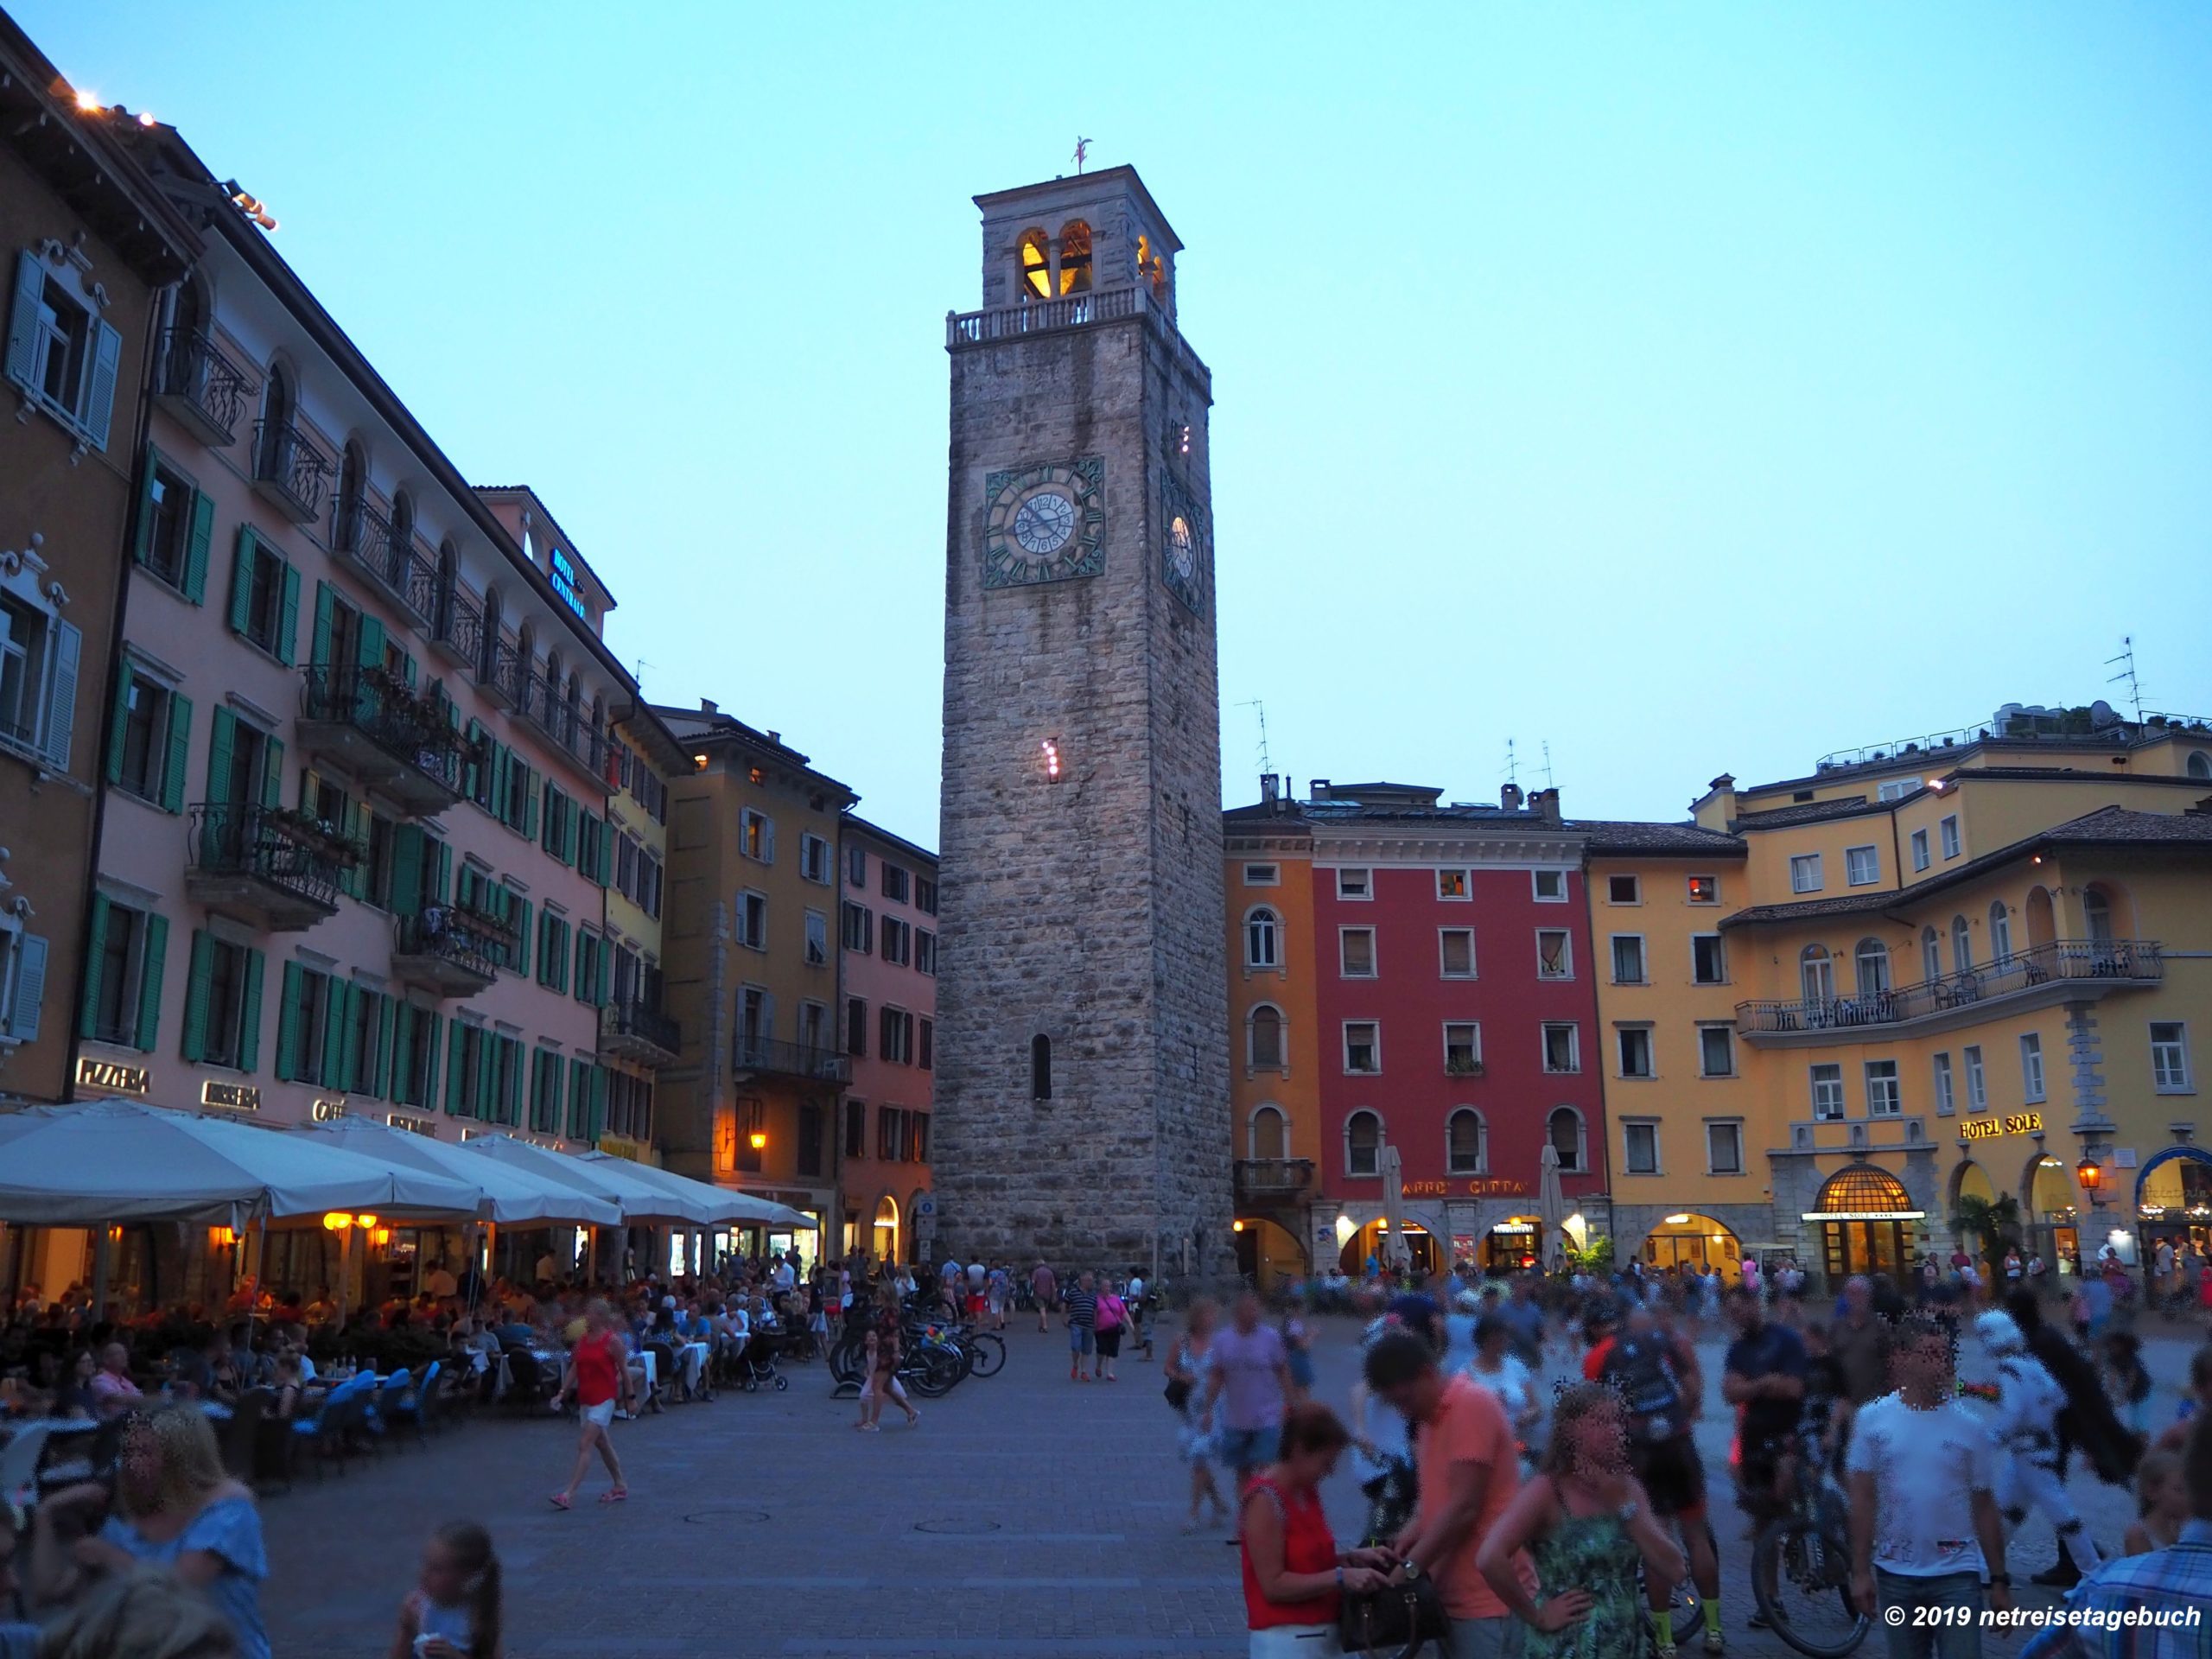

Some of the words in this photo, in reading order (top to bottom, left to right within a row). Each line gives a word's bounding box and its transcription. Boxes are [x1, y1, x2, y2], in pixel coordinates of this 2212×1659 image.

[1029, 501, 1037, 511] 11
[1039, 497, 1049, 507] 12
[1059, 504, 1066, 513] 2
[1020, 511, 1029, 519] 10
[1064, 515, 1071, 525] 3
[1018, 522, 1026, 531] 9
[1021, 533, 1028, 543] 8
[1052, 536, 1059, 546] 5
[1030, 539, 1037, 550] 7
[1040, 541, 1048, 551] 6
[554, 548, 575, 587] HOTEL
[553, 572, 585, 619] CENTRALE
[77, 1058, 150, 1093] PIZZERIA
[1960, 1120, 2001, 1139] HOTEL
[2005, 1113, 2041, 1134] SOLE
